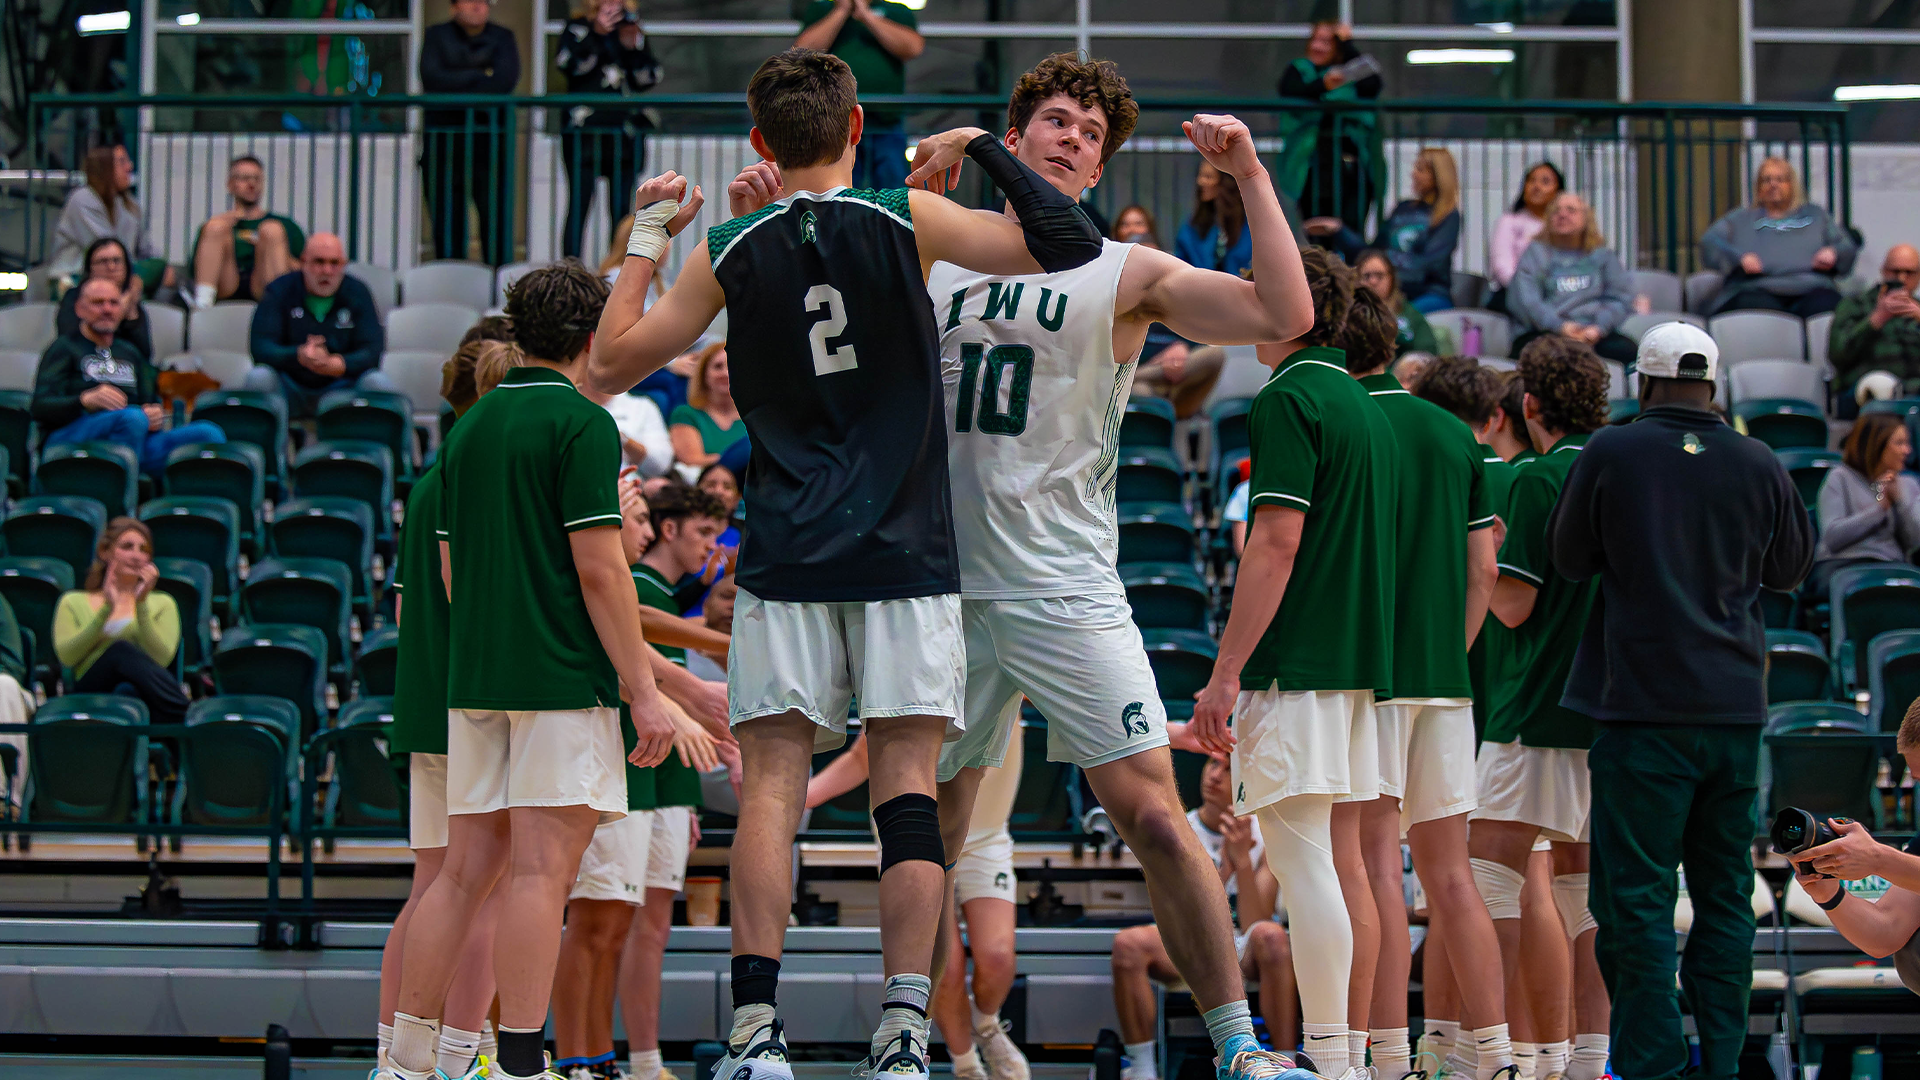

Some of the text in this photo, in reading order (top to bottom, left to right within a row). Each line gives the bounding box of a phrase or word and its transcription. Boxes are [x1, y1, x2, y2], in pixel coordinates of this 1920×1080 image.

[803, 283, 859, 377] 2
[944, 282, 1069, 333] IWU
[954, 342, 1036, 437] 10
